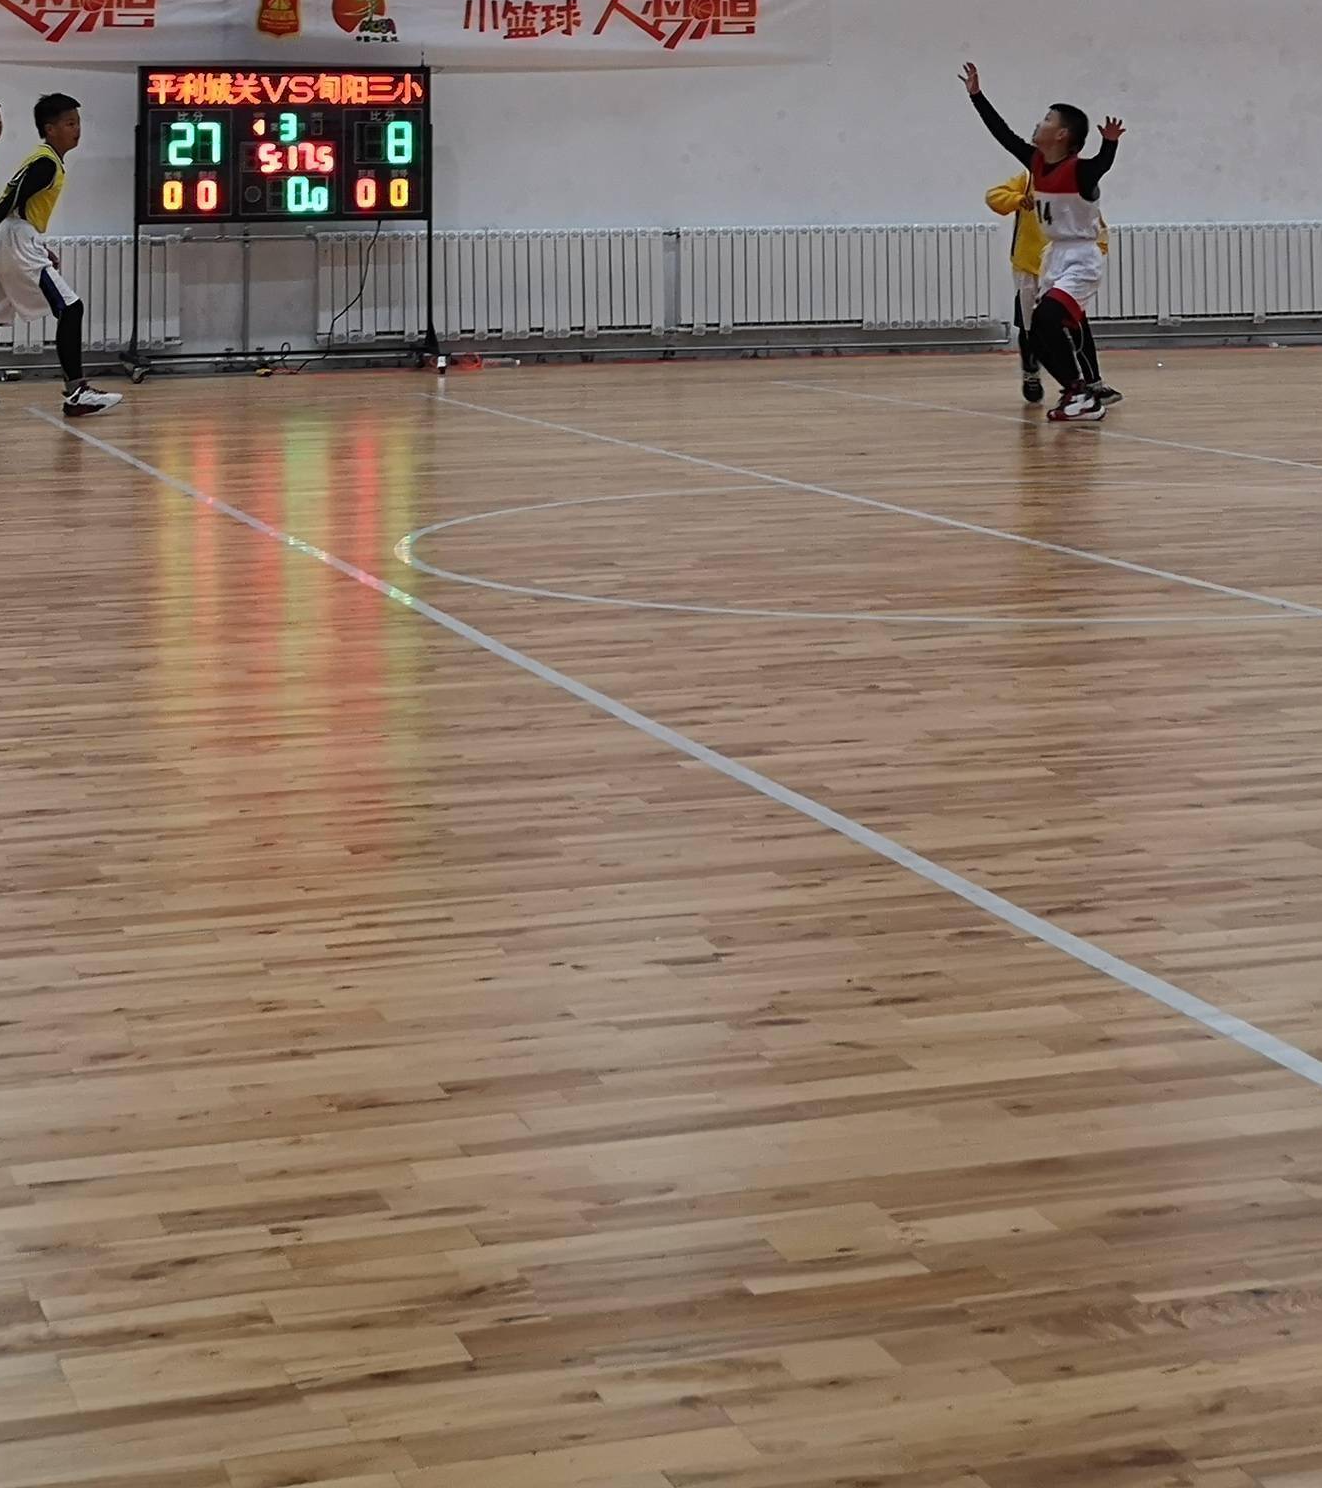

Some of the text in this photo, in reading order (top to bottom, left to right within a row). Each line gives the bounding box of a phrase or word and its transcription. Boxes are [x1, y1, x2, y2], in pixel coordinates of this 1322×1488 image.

[280, 112, 298, 141] 3
[168, 122, 221, 166] 27
[387, 121, 412, 164] 8
[163, 180, 183, 210] 0
[197, 179, 217, 210] 0
[356, 178, 376, 208] 0
[390, 178, 409, 207] 0
